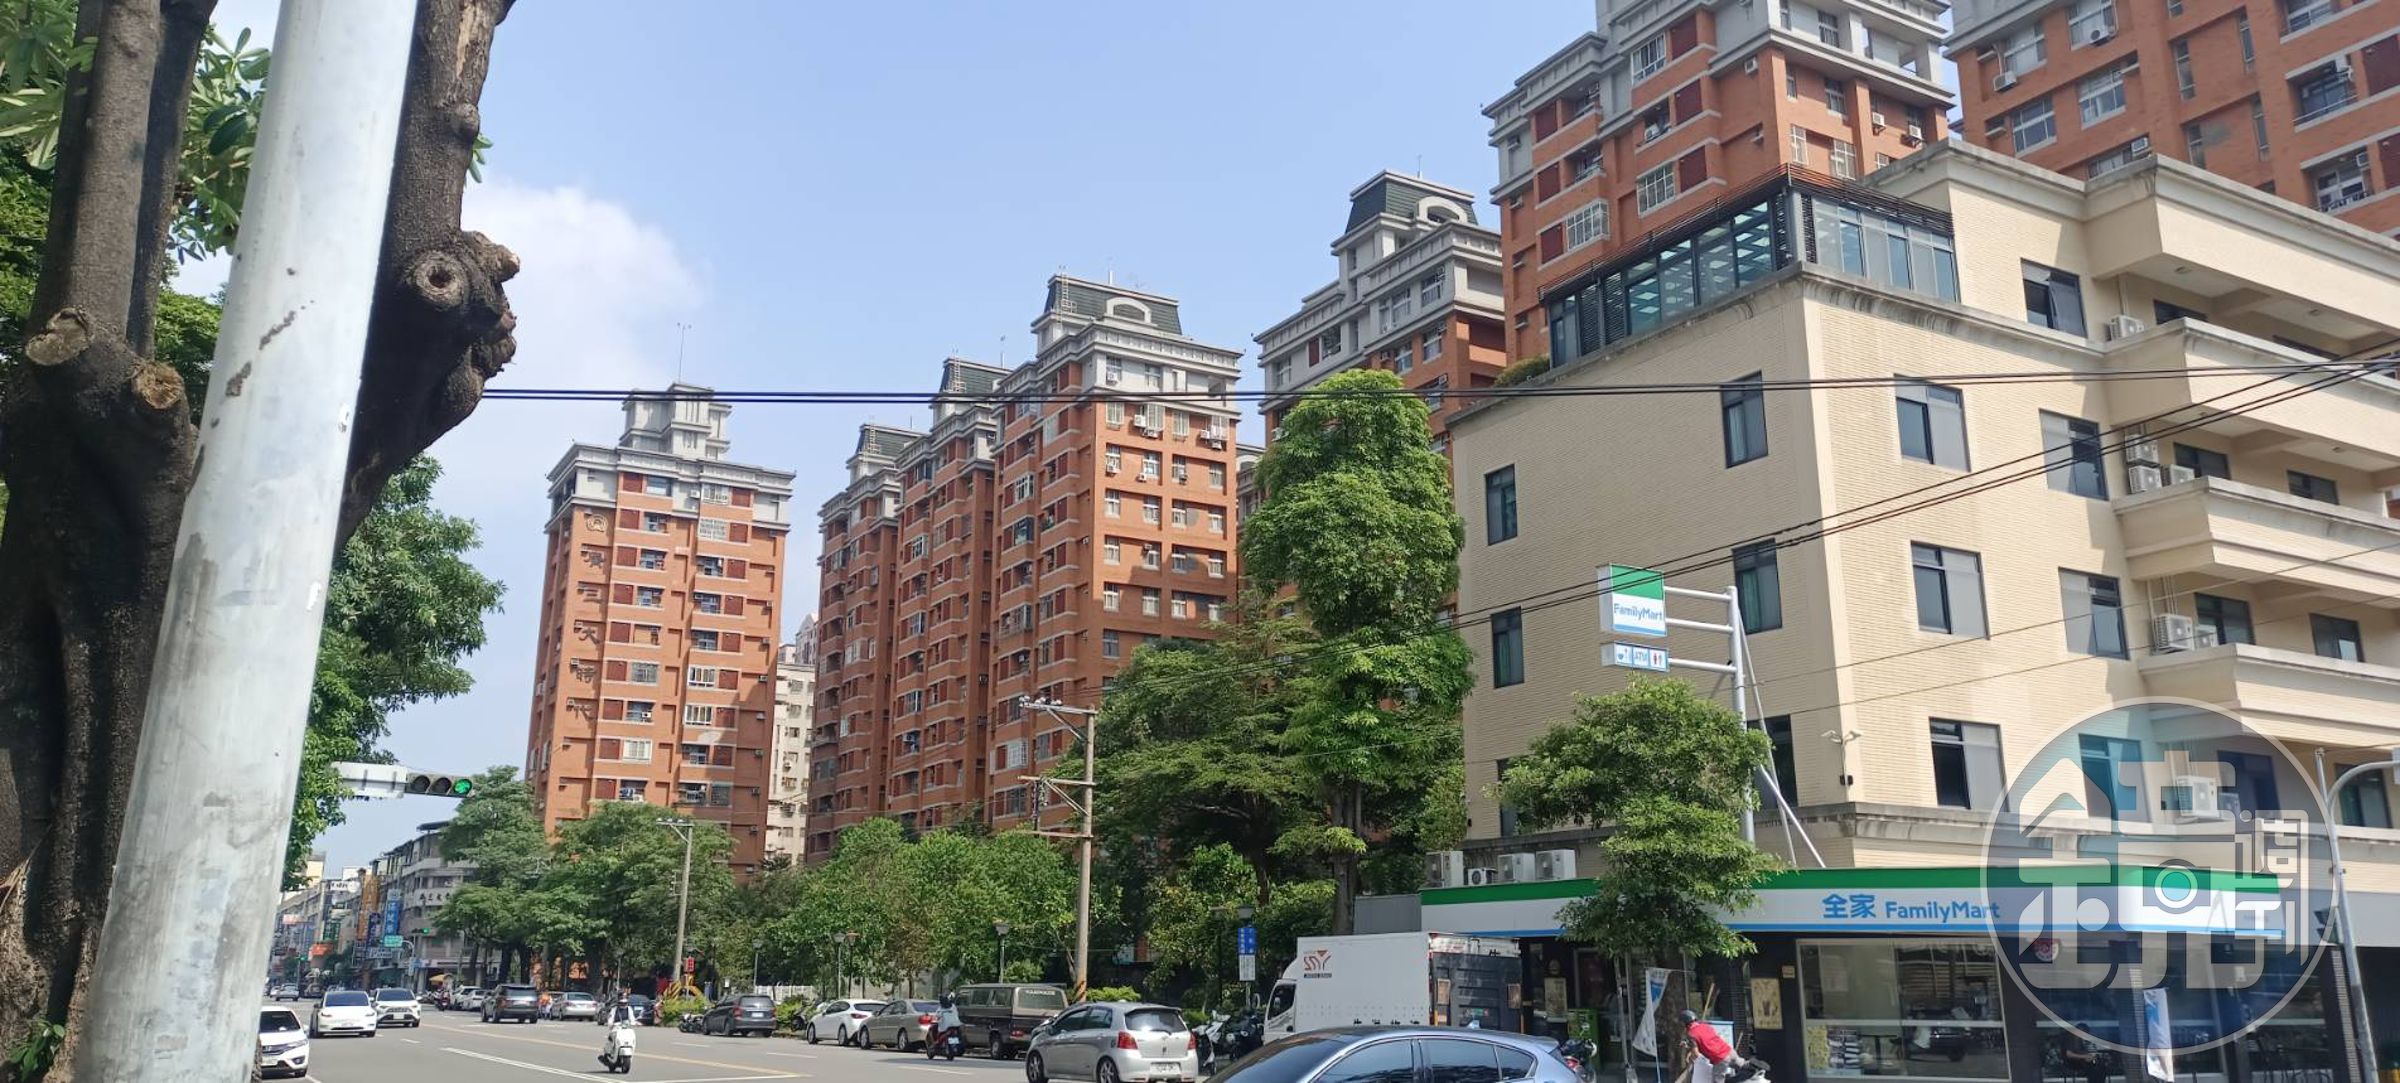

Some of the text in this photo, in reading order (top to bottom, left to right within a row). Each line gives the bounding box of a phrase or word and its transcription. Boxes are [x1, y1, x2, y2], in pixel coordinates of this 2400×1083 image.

[1614, 603, 1663, 621] FamilyMart
[1822, 894, 2001, 923] 全家 FamilyMart
